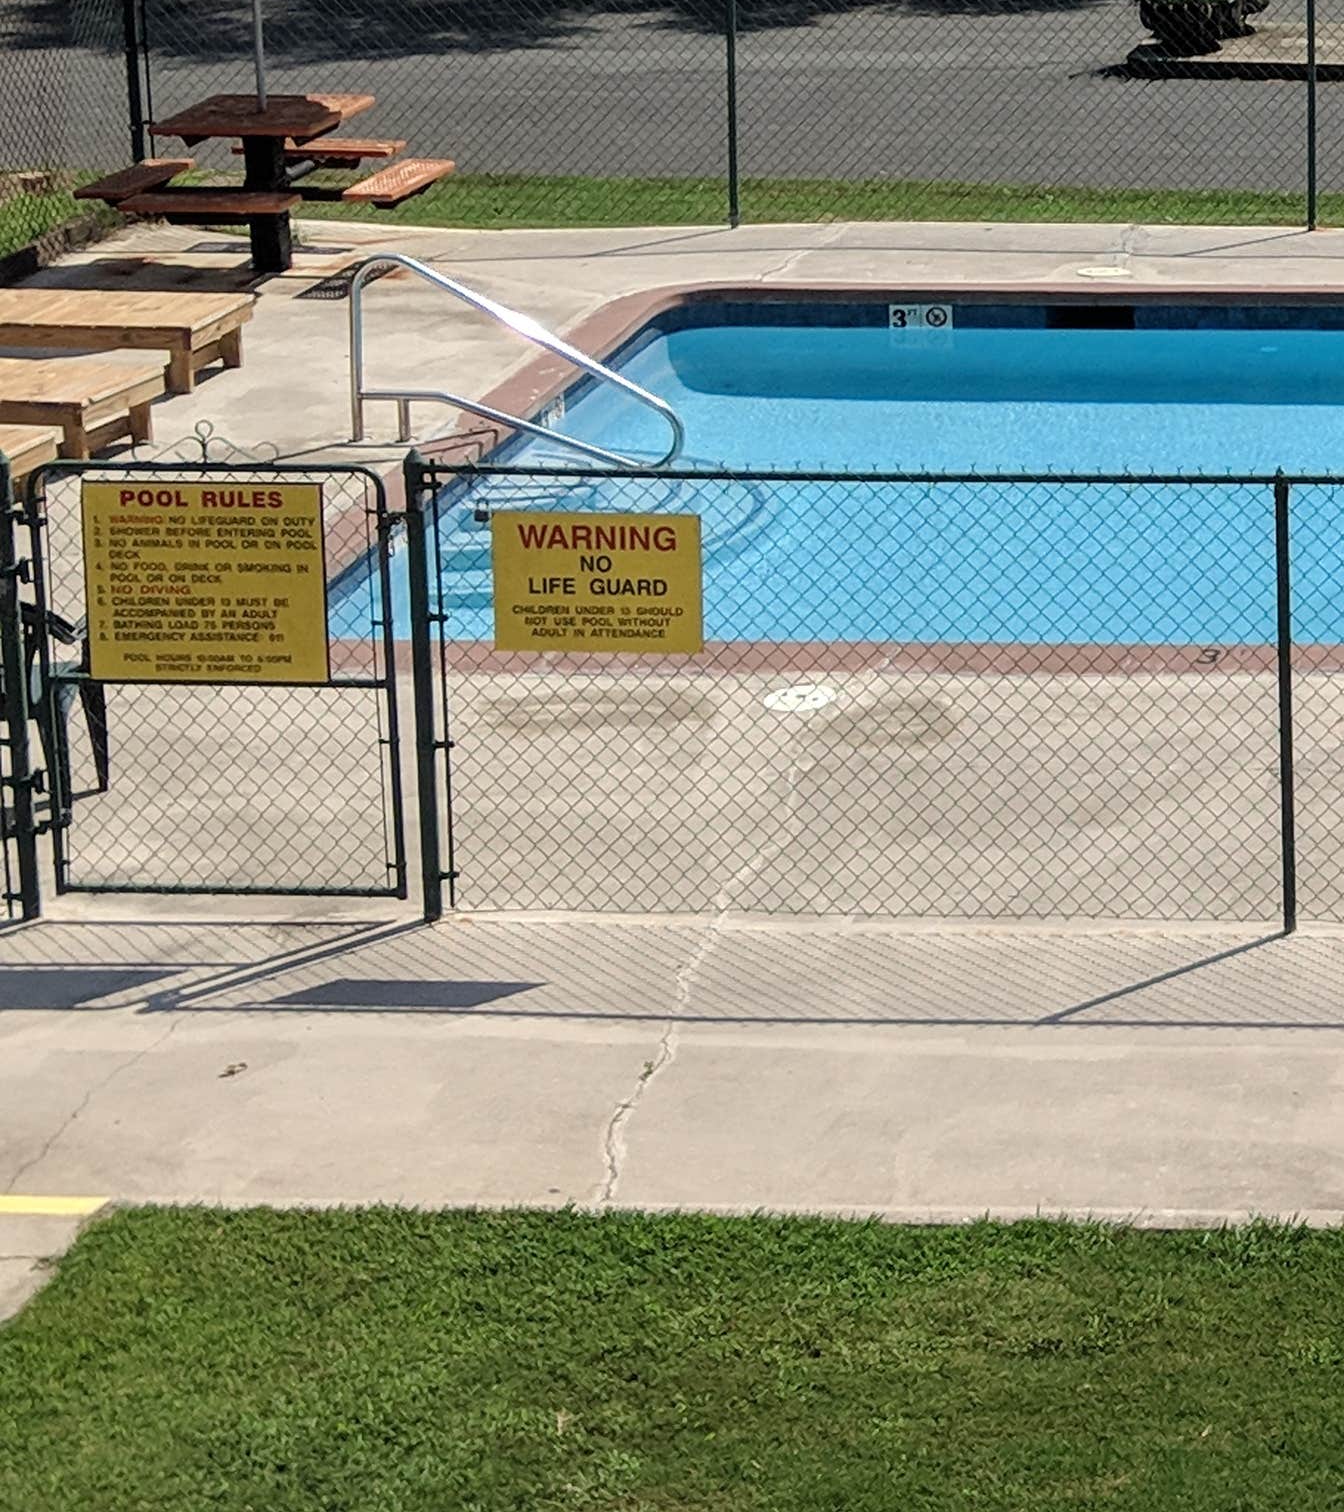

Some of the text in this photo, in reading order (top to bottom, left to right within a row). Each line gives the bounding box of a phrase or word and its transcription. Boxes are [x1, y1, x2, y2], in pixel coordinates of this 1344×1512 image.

[892, 309, 907, 328] 3
[120, 490, 284, 508] POOL RULES
[168, 515, 186, 525] NO
[191, 516, 256, 526] LIFEGUARD
[261, 517, 278, 526] ON
[283, 516, 315, 527] DUTY
[217, 528, 275, 538] ENTERING
[281, 529, 313, 539] POOL
[518, 524, 677, 552] WARNING
[109, 539, 127, 548] NO
[188, 539, 200, 548] IN
[205, 539, 237, 549] POOL
[241, 540, 258, 549] OR
[264, 540, 281, 549] ON
[286, 541, 318, 550] POOL
[109, 550, 141, 561] DECK
[110, 561, 128, 571] NO
[214, 563, 232, 573] OR
[237, 563, 292, 574] SMOKING
[296, 564, 309, 574] IN
[580, 555, 612, 573] NO
[110, 573, 222, 584] POOL OR ON DECK
[110, 584, 134, 594] NO
[140, 584, 191, 596] DIVING
[528, 577, 668, 596] LIFE GUARD
[112, 596, 170, 606] CHILDREN
[175, 597, 215, 607] UNDER
[236, 598, 268, 607] MUST
[274, 598, 289, 608] BE
[113, 608, 278, 620] ACCOMPANIED BY AN ADULT
[512, 605, 569, 615] CHILDREN
[575, 605, 615, 615] UNDER
[636, 606, 684, 617] SHOULD
[113, 620, 163, 630] BATHING
[168, 620, 199, 630] LOAD
[222, 620, 276, 631] PERSONS
[524, 616, 671, 628] NOT USE POOL WITHOUT
[114, 632, 186, 642] EMERGENCY
[531, 628, 666, 639] ADULT IN ATTENDANCE
[123, 653, 152, 663] POOL
[240, 654, 254, 663] TO
